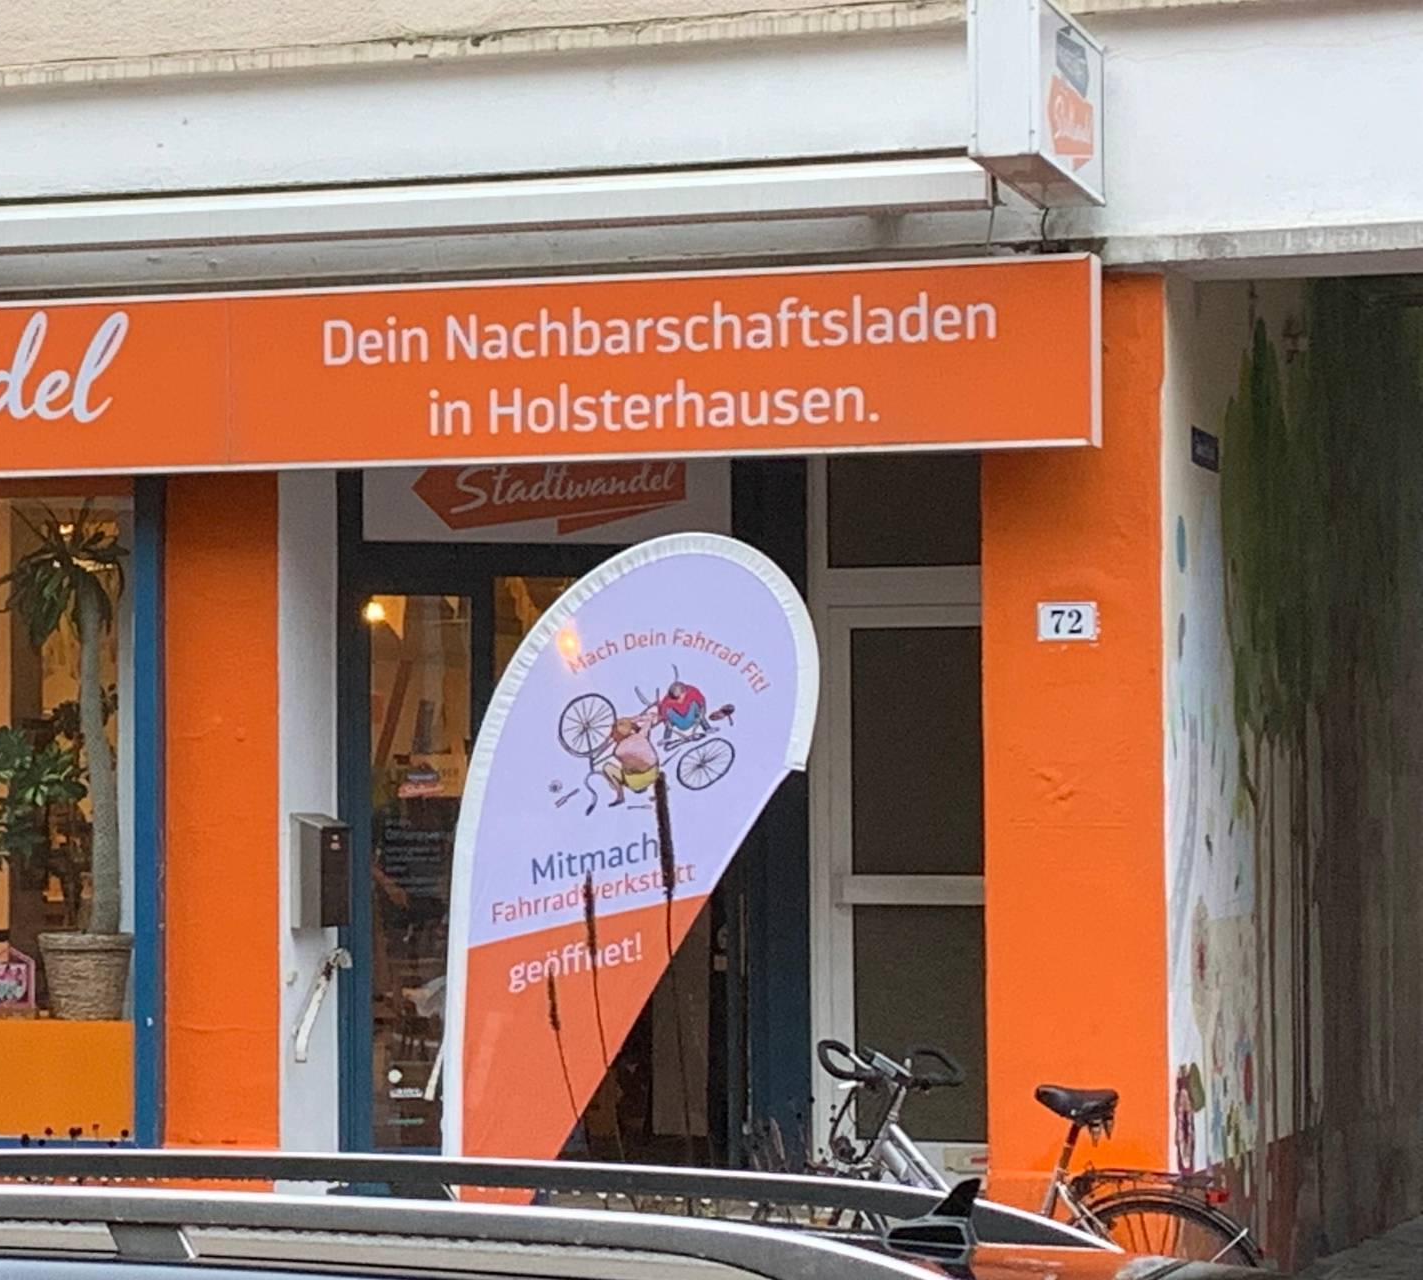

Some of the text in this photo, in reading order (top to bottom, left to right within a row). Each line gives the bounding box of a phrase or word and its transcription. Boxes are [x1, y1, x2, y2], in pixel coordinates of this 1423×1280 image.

[323, 291, 998, 367] Dein Nachbarschaftsladen
[429, 379, 880, 436] in Holsterhausen.
[450, 462, 675, 514] Stadtwandel
[1050, 609, 1083, 634] 72
[568, 628, 771, 695] Mach Dein Fahrrad Fit!
[531, 833, 660, 884] Mitmach
[491, 863, 696, 924] Fahrradwerksttt
[508, 931, 643, 993] geöffnet!
